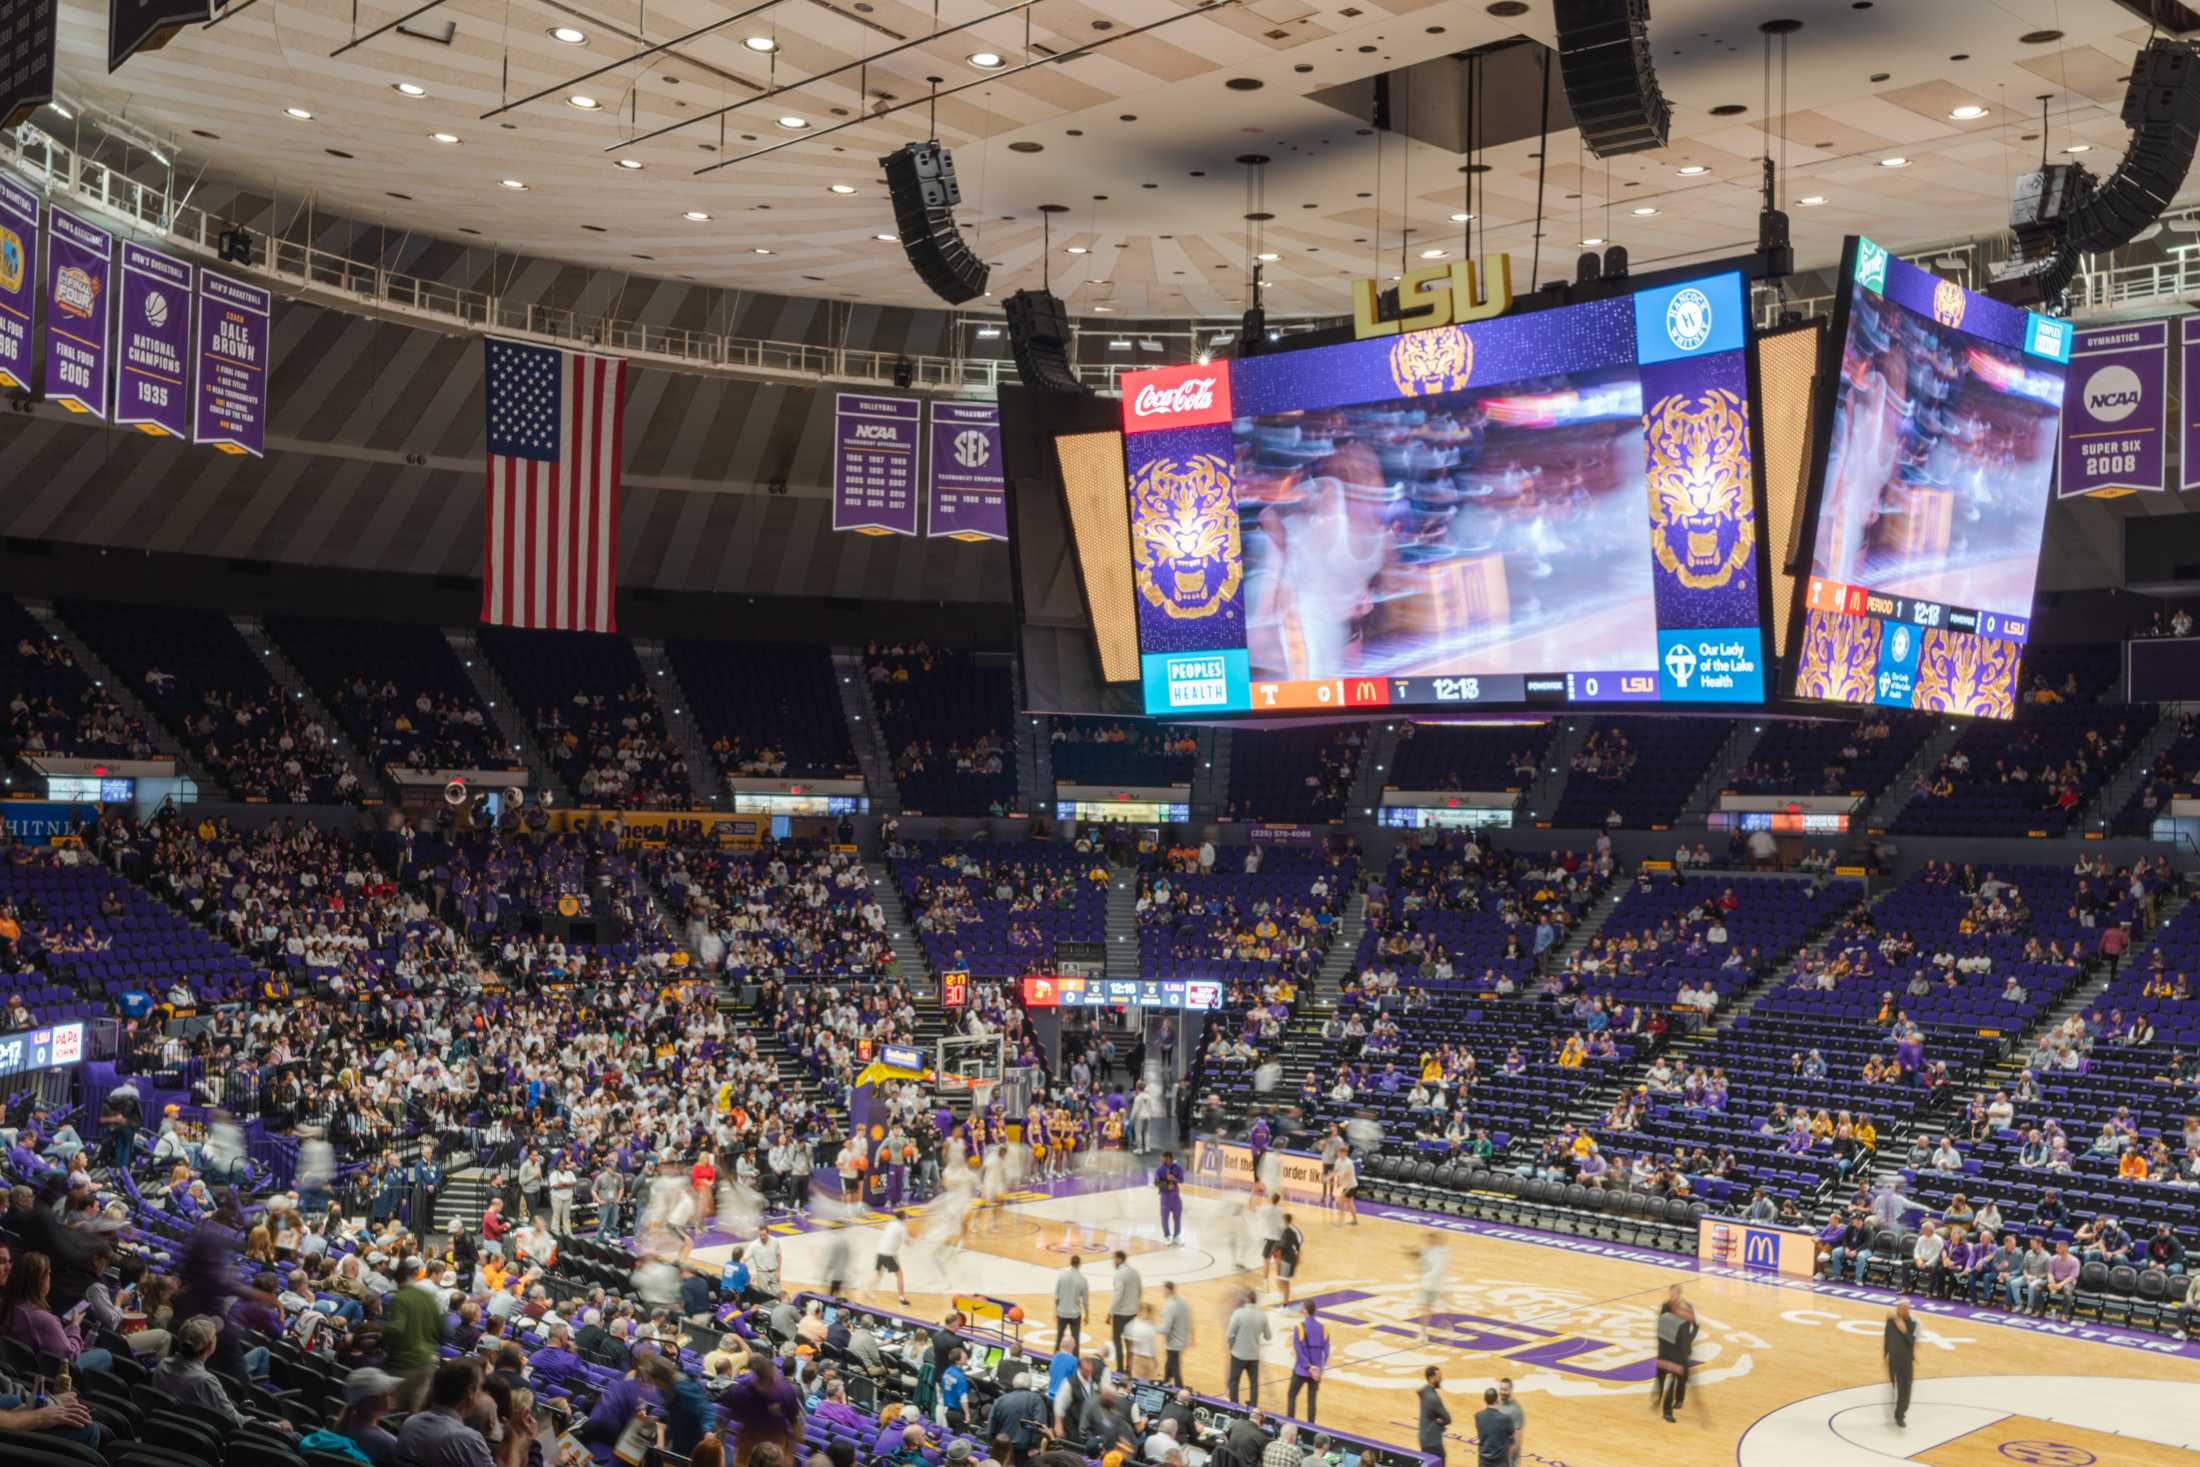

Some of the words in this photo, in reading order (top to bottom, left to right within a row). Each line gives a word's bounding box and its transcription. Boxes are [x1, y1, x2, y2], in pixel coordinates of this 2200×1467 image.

[228, 284, 262, 306] BASKETBALL
[1352, 253, 1513, 340] LSU
[226, 311, 245, 323] COACH
[220, 320, 248, 343] DALE
[2087, 332, 2140, 347] GYMNASTICS
[56, 341, 76, 361] FINAL
[77, 349, 95, 368] FOUR
[134, 333, 176, 359] NATIONAL
[212, 334, 256, 362] BROWN
[128, 346, 181, 374] CHAMPIONS
[60, 360, 91, 389] 2006
[138, 381, 168, 407] 1935
[2090, 390, 2139, 409] NCAA
[860, 402, 897, 412] VOLLEYBALL
[855, 424, 897, 440] NCAA
[953, 430, 990, 467] SEC
[2081, 443, 2119, 456] SUPER
[2121, 440, 2141, 452] SIX
[2086, 455, 2136, 475] 2008
[1866, 596, 1894, 616] PERIOD
[1986, 616, 1996, 633] 0
[2004, 620, 2026, 637] LSU
[1699, 642, 1719, 657] Our
[1720, 641, 1745, 660] Lady
[1171, 661, 1223, 680] PEOPLES
[1700, 658, 1712, 673] of
[1713, 658, 1730, 672] the
[1730, 658, 1754, 673] Lake
[1317, 685, 1332, 702] 0
[1398, 686, 1406, 699] 1
[1586, 677, 1599, 696] 0
[1621, 677, 1654, 693] LSU
[1701, 674, 1734, 689] Health
[1174, 684, 1224, 700] HEALTH
[1164, 983, 1186, 993] LSU
[1065, 991, 1076, 1004] 0
[1169, 993, 1180, 1006] 0
[33, 1031, 51, 1045] LSU
[55, 1030, 79, 1045] PAPA
[36, 1046, 46, 1065] 0
[1224, 1154, 1238, 1170] Get
[1282, 1166, 1307, 1184] order
[1308, 1169, 1322, 1184] lik
[1377, 1211, 1478, 1231] PETE
[1481, 1228, 1693, 1269] MARAVICH
[1700, 1265, 1955, 1312] ASSEMBY
[1968, 1312, 2185, 1353] CENTER
